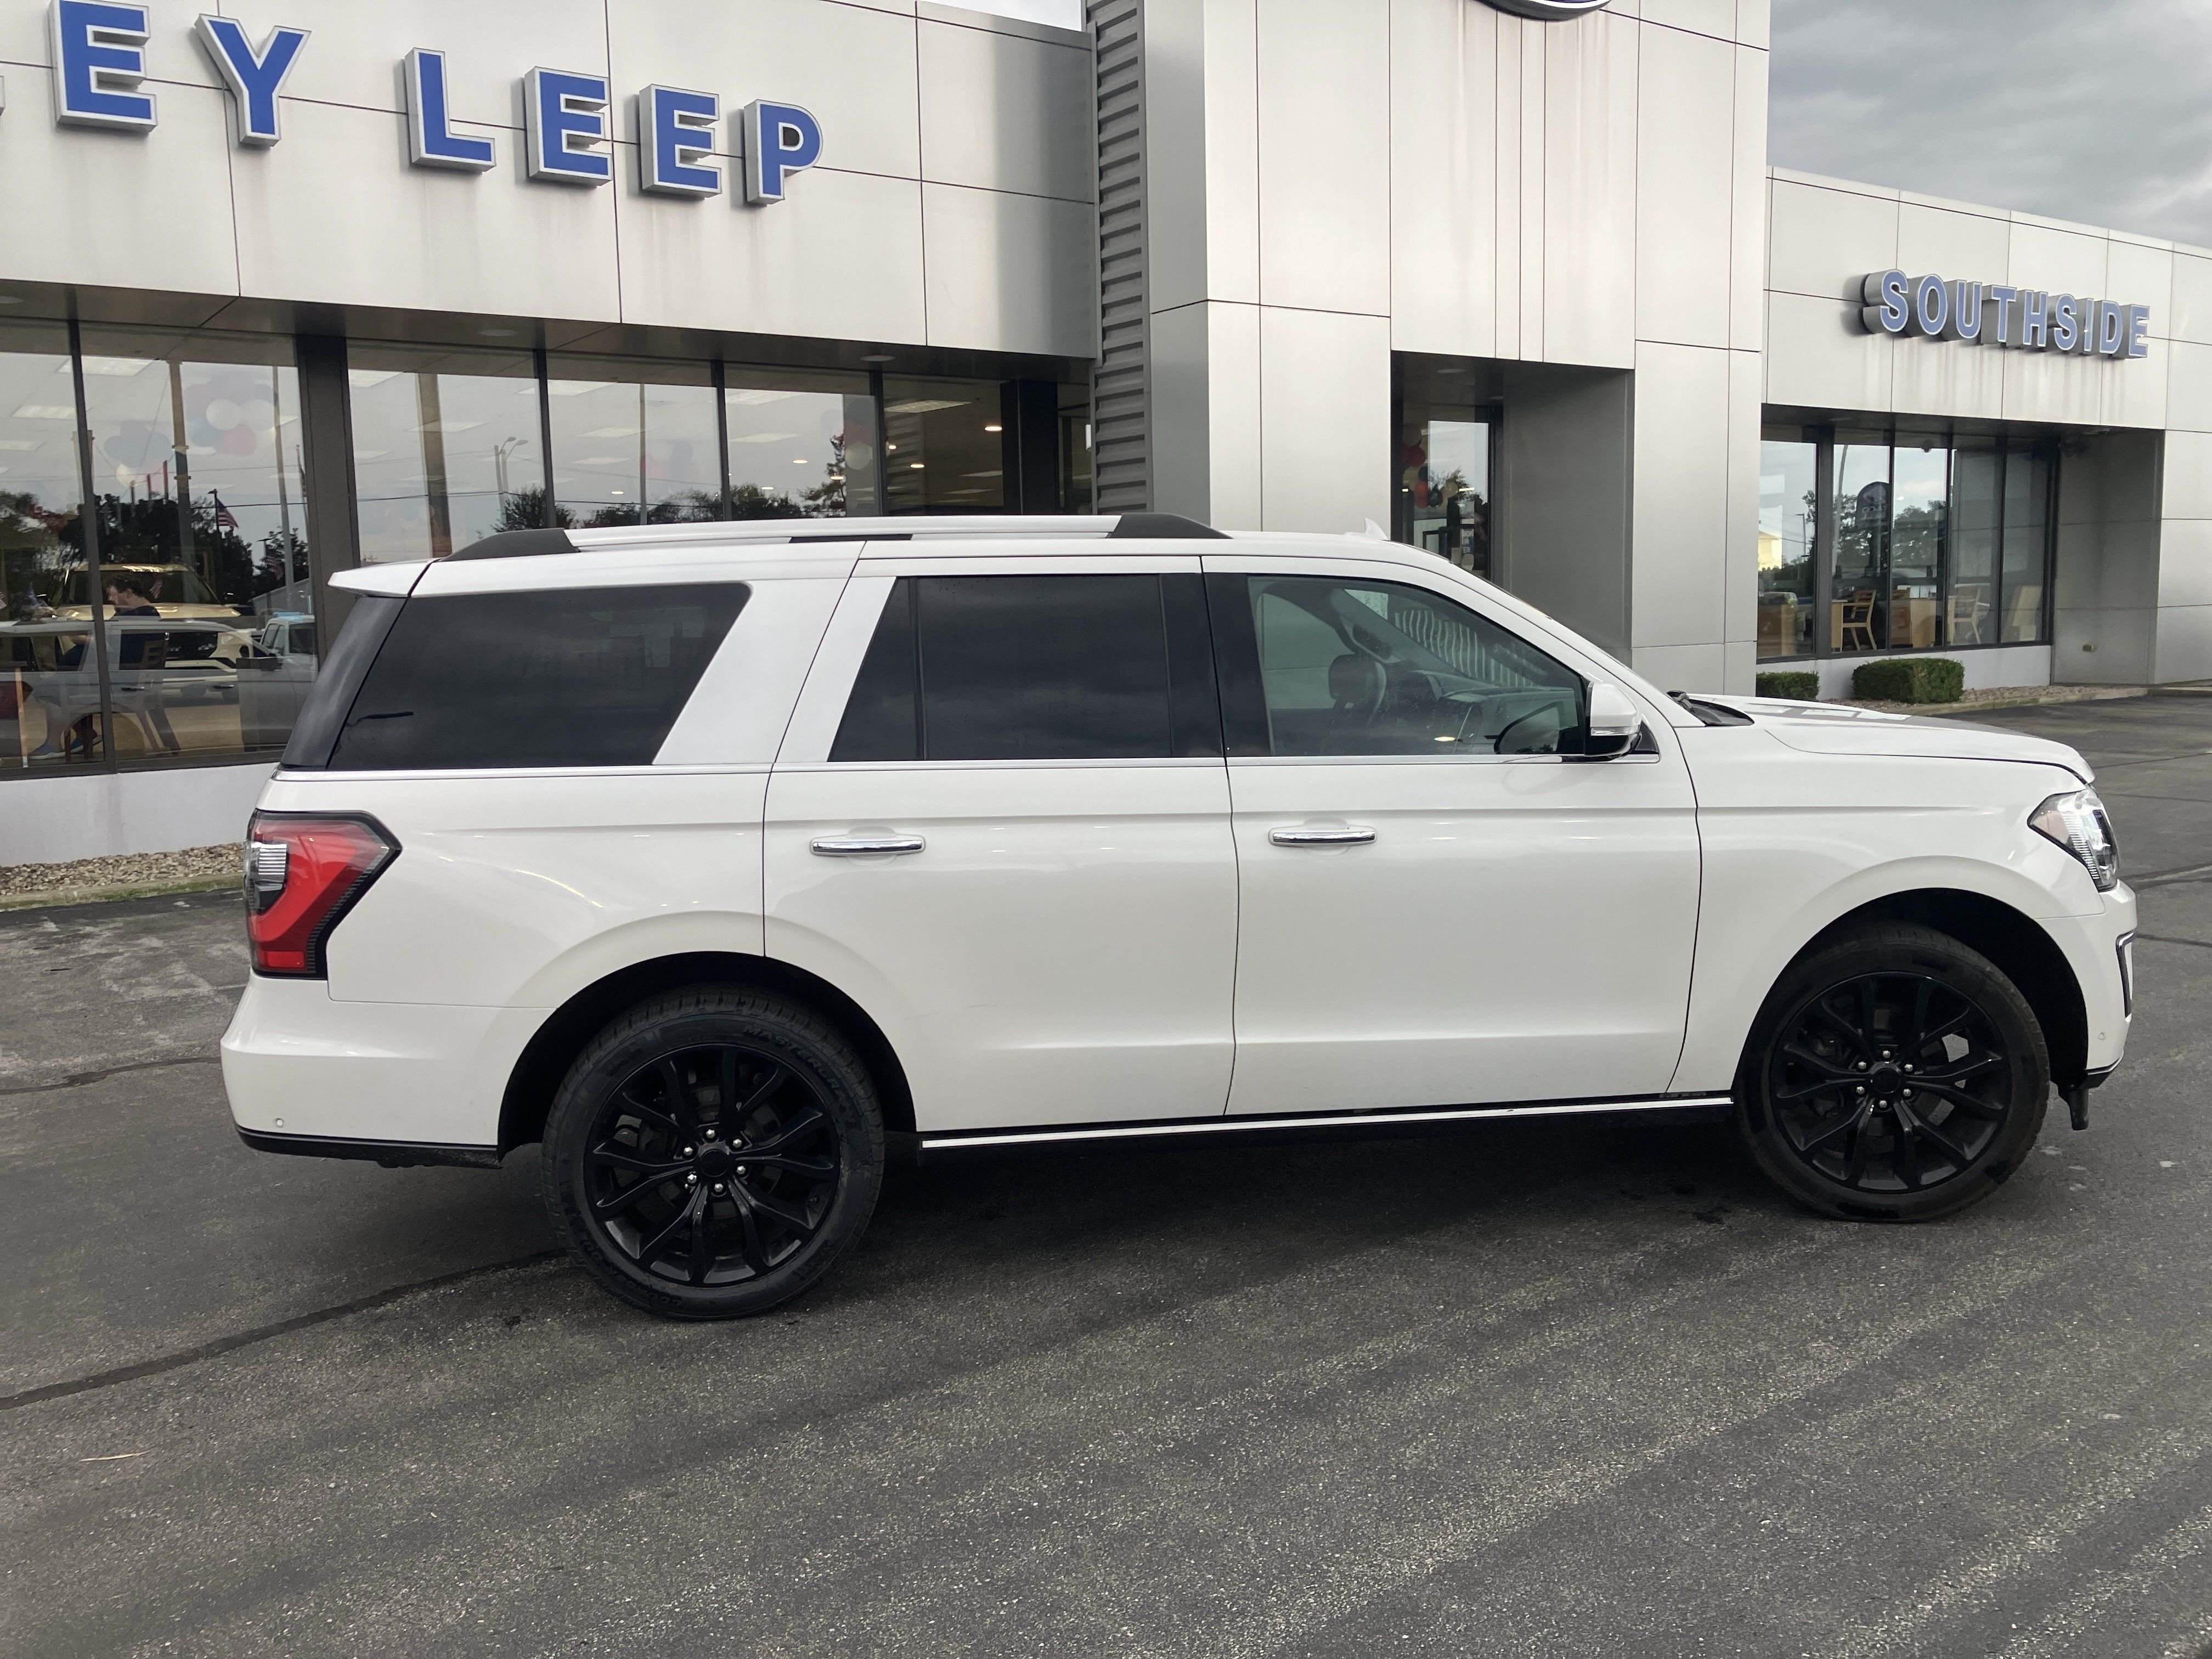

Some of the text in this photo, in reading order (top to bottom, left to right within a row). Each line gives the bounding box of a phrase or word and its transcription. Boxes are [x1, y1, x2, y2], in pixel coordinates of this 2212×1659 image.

[0, 0, 823, 205] EY LEEP
[1864, 269, 2150, 359] SOUTHSIDE
